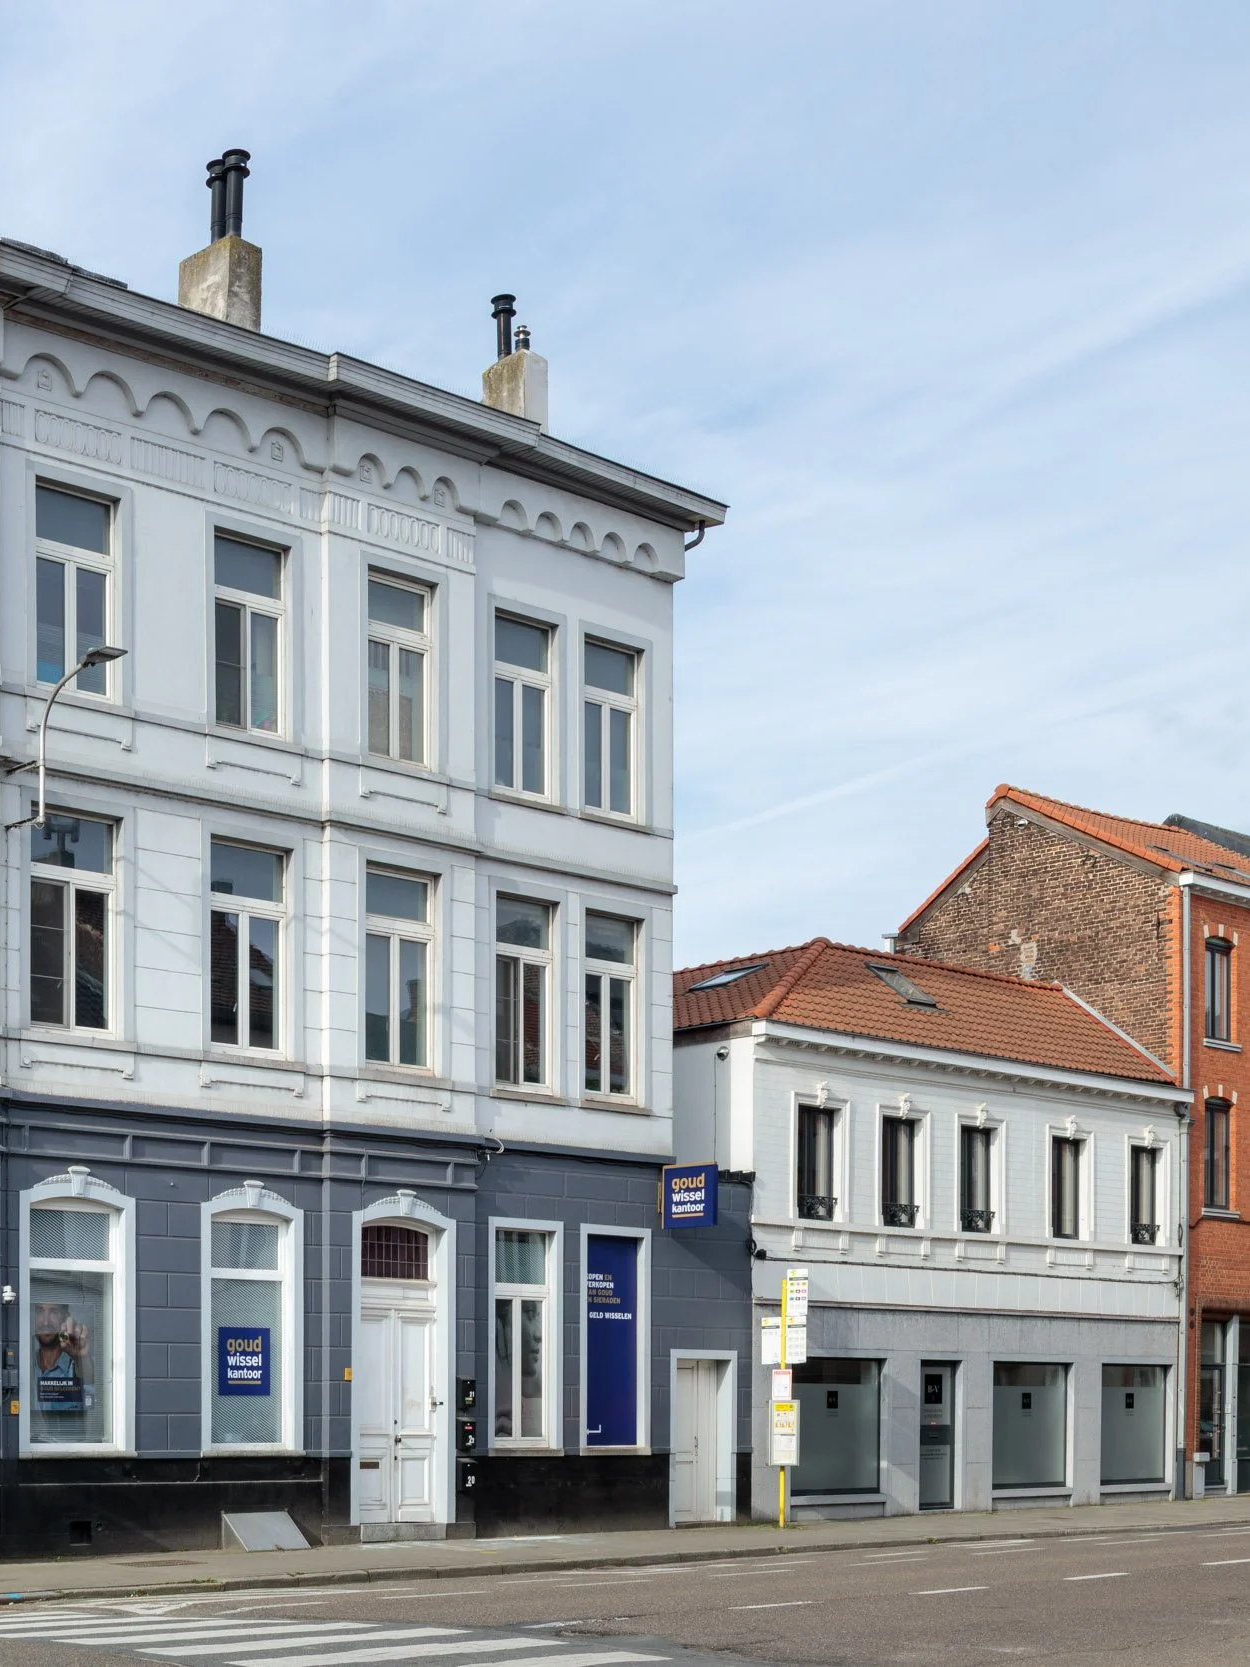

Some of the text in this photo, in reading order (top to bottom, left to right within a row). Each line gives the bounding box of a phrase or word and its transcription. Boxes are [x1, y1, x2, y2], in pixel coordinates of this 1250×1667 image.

[672, 1173, 705, 1192] goud
[672, 1189, 705, 1202] wissel
[672, 1203, 705, 1213] kantoor
[605, 1312, 632, 1320] WISSELEN
[227, 1336, 262, 1354] goud
[227, 1353, 262, 1366] wissel
[227, 1368, 262, 1378] kantoor
